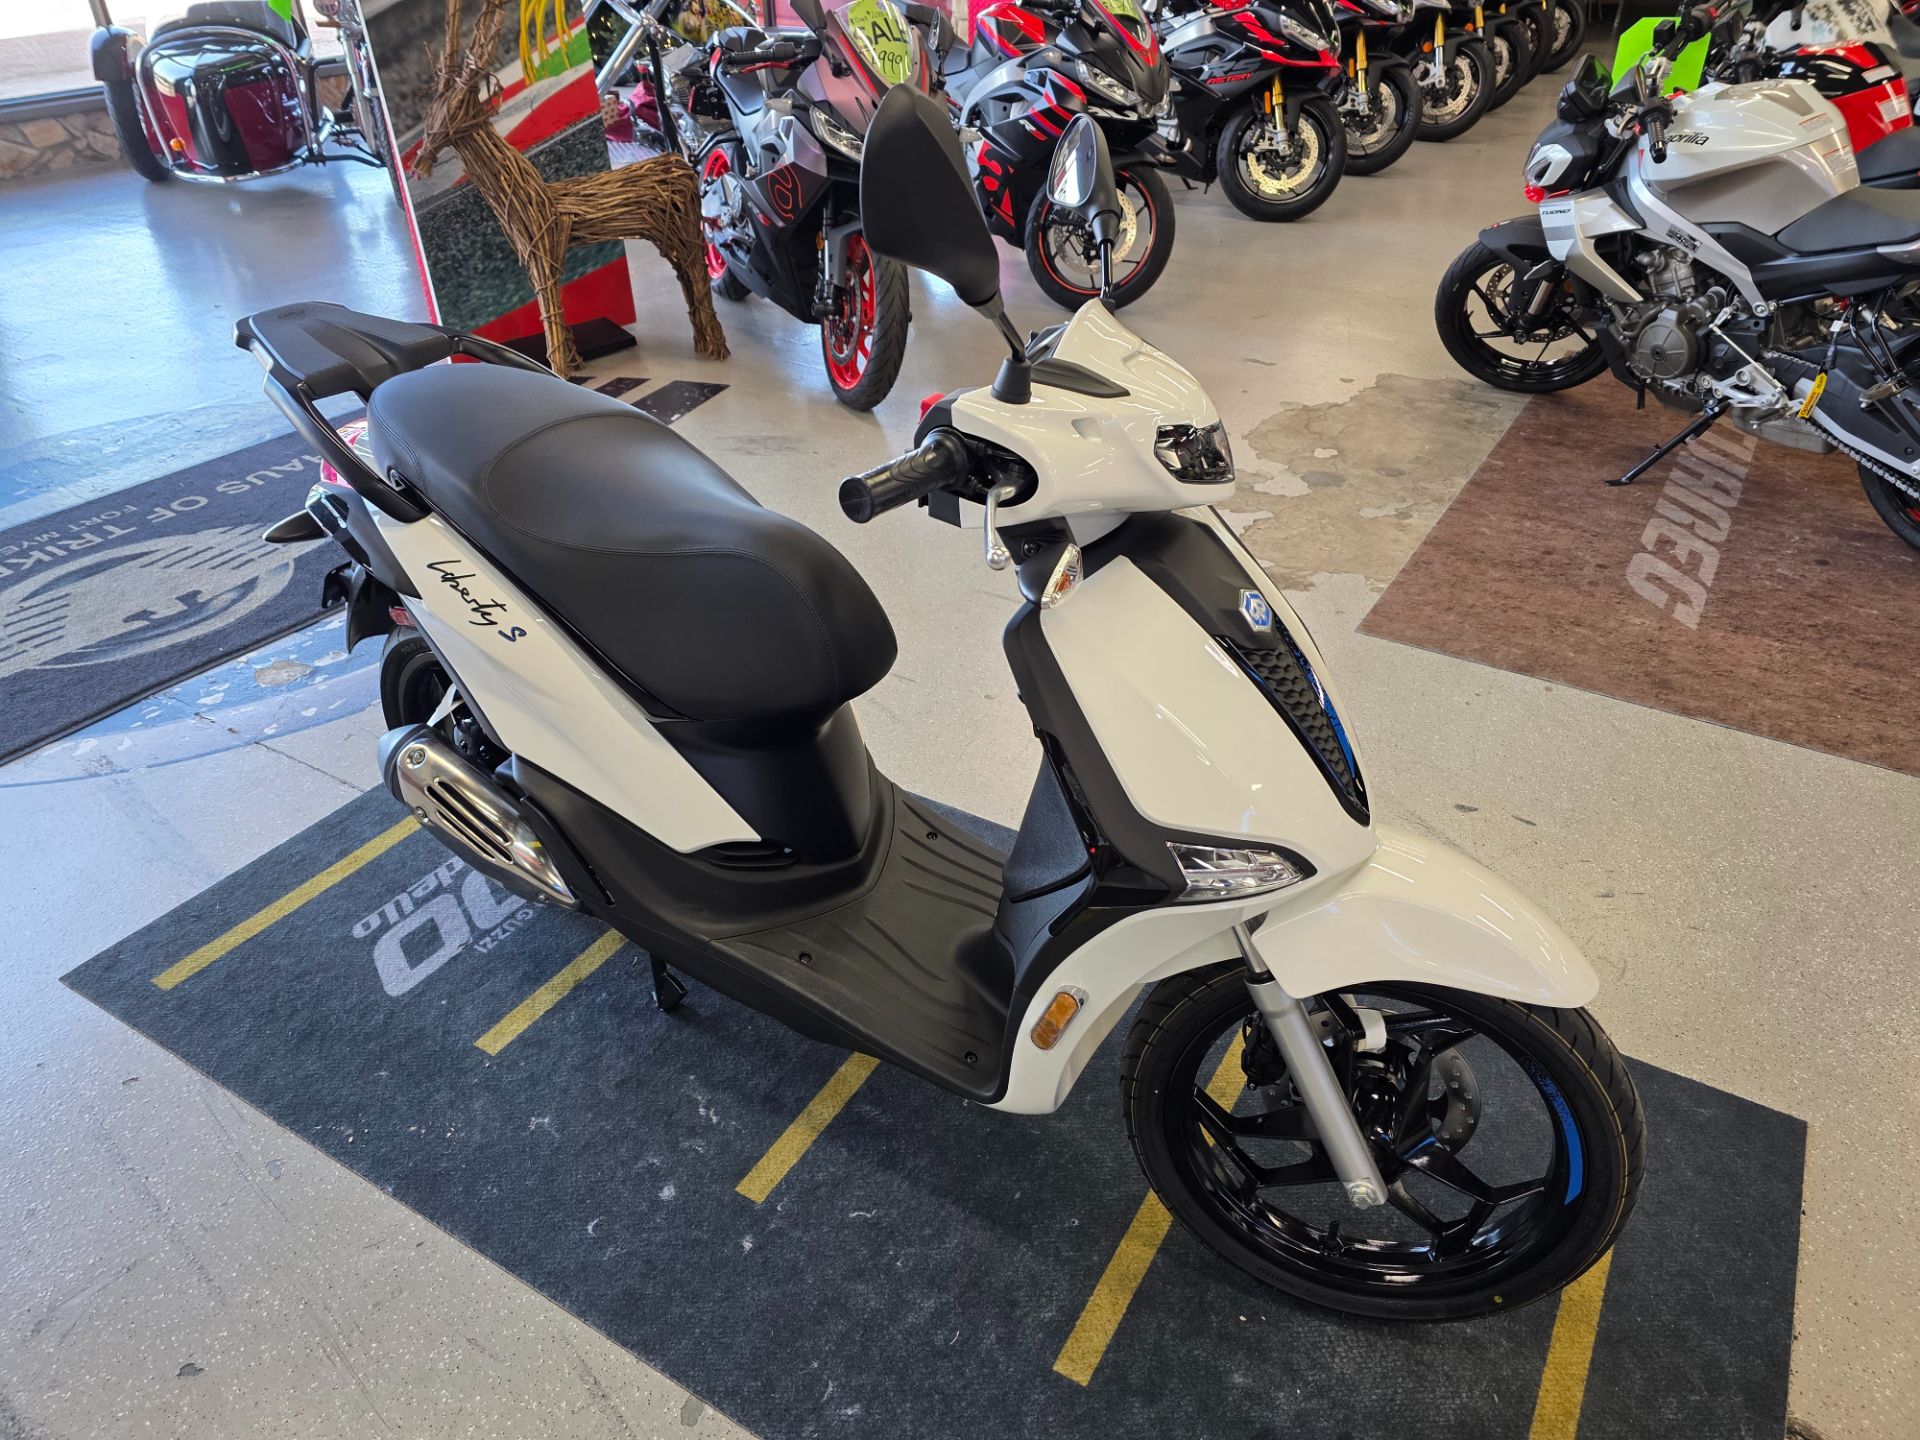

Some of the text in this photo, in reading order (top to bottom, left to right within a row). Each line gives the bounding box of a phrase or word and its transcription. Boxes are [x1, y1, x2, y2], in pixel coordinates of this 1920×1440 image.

[1205, 72, 1253, 85] FACTORY
[69, 504, 139, 532] FORT
[146, 495, 209, 523] OF
[426, 559, 528, 642] Liberty S
[473, 908, 535, 954] GUZZI
